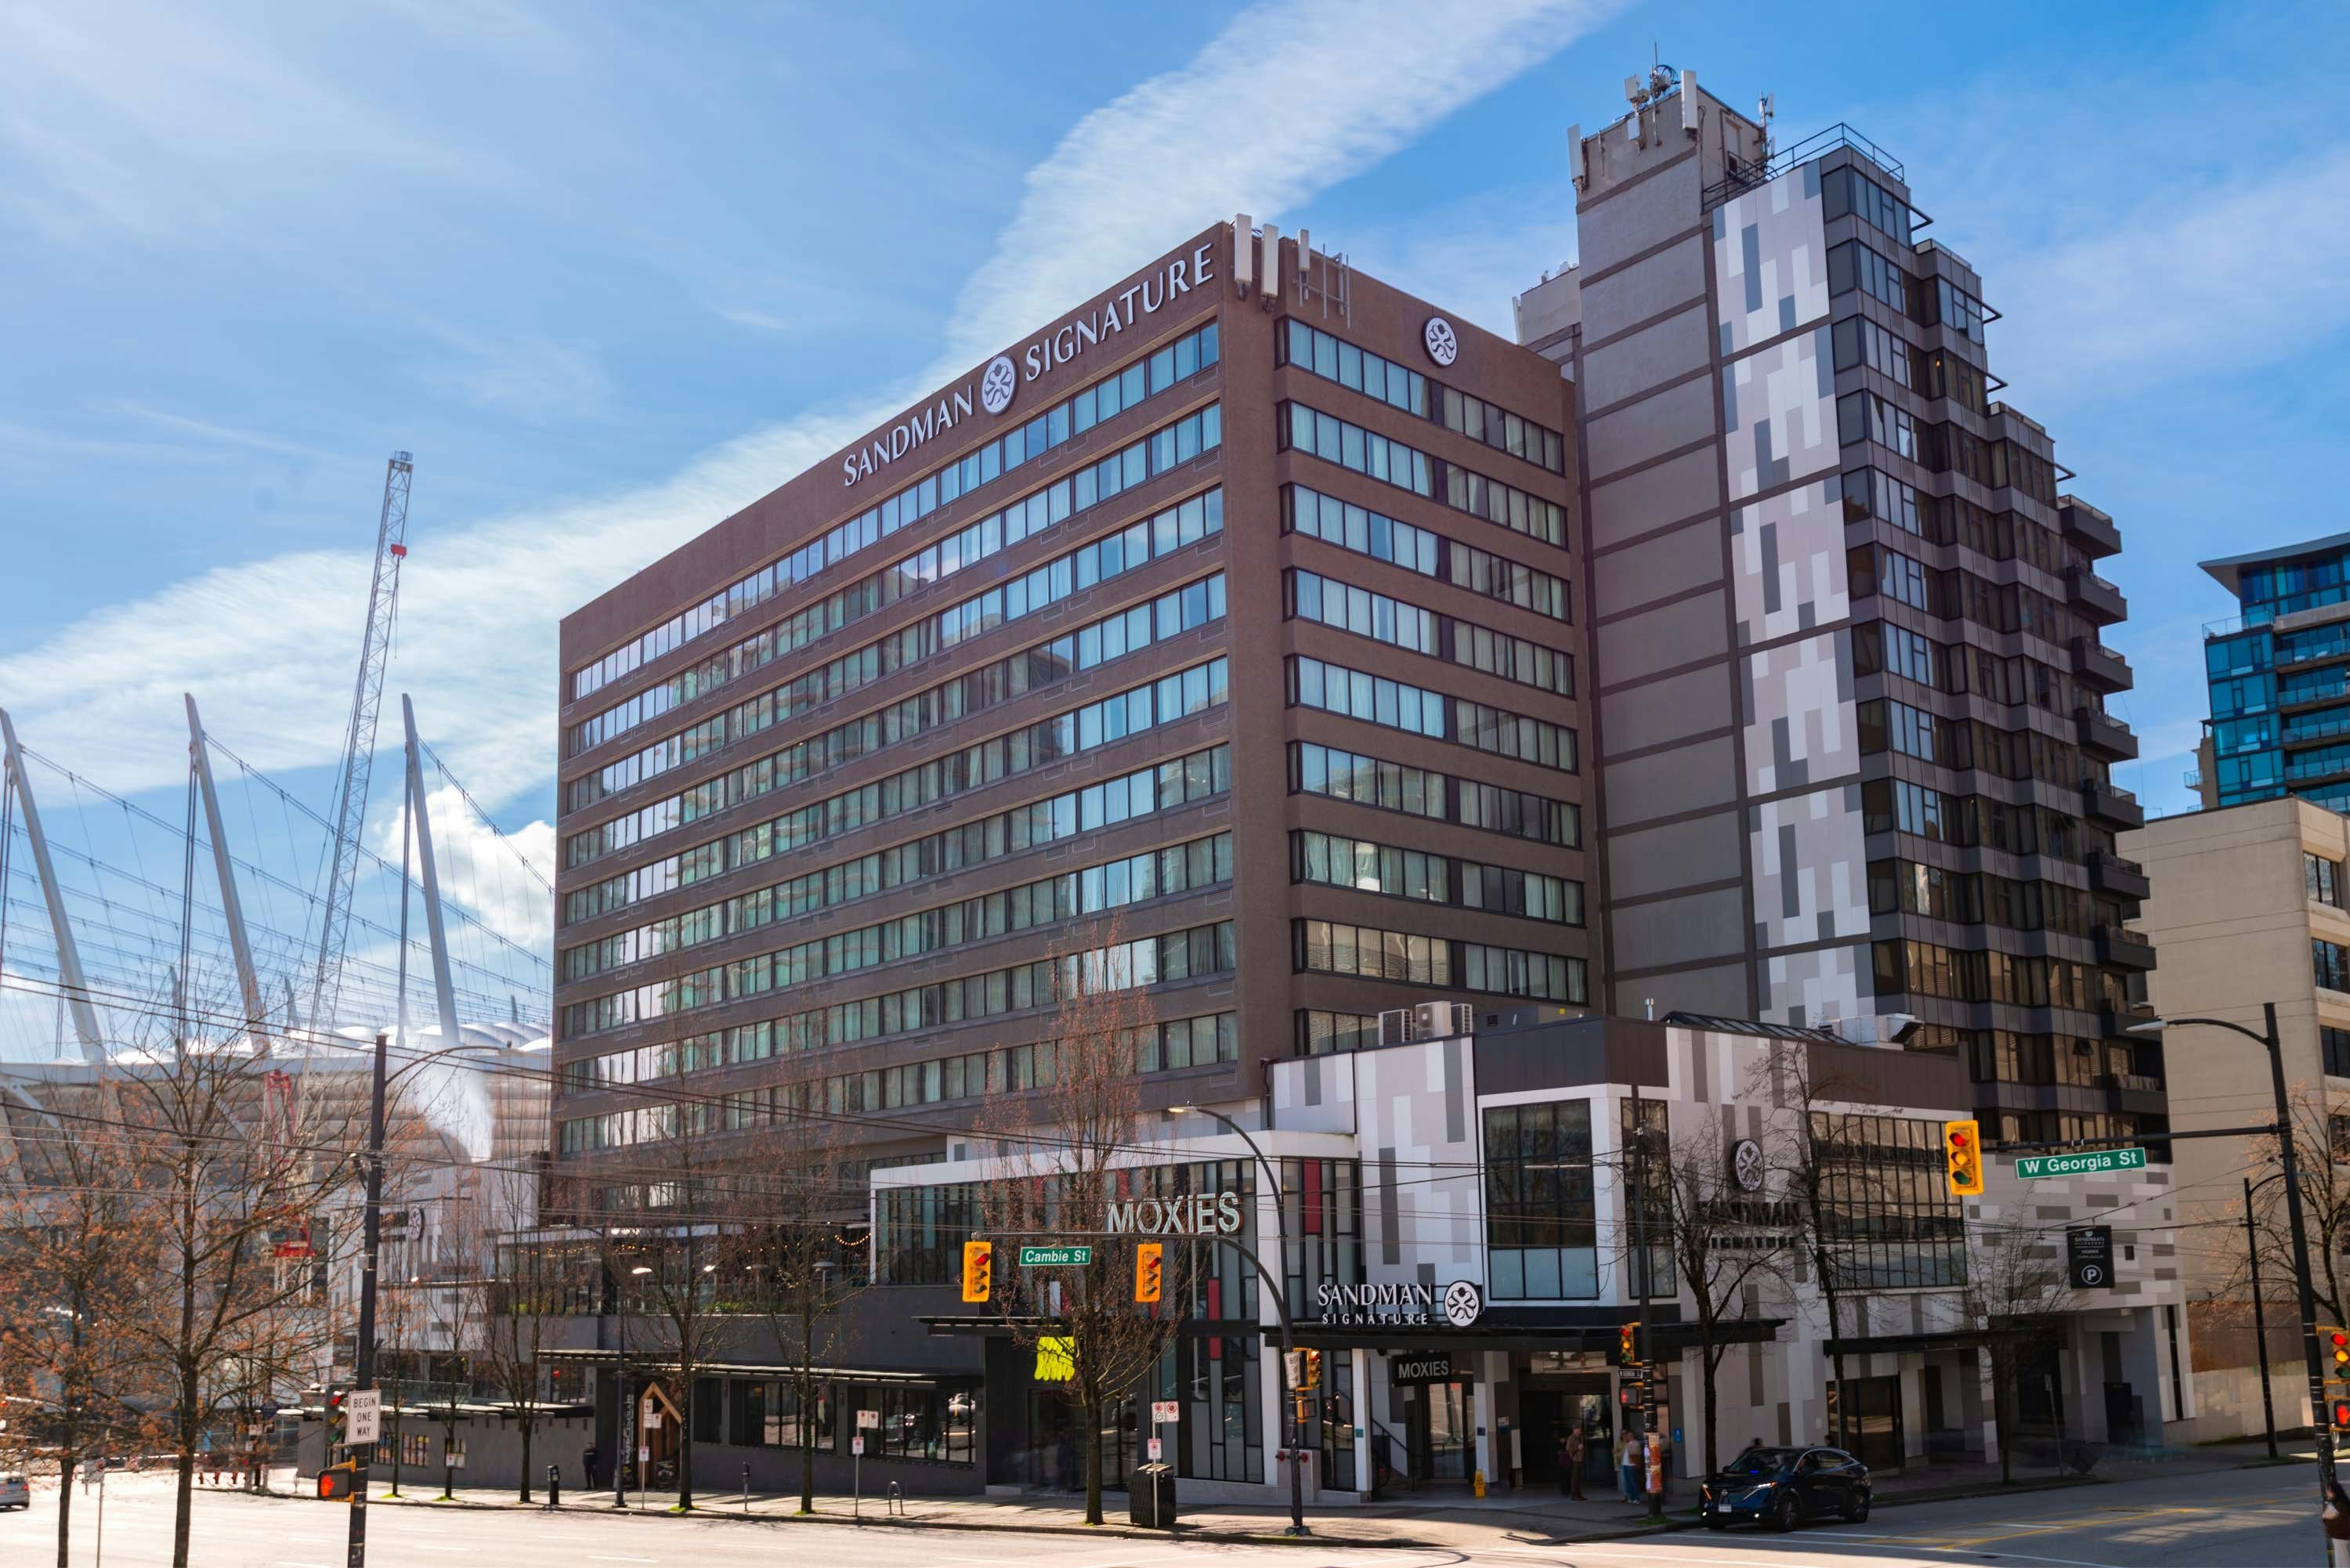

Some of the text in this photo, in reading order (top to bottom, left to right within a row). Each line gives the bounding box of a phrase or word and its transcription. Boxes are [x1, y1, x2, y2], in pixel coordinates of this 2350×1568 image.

[844, 243, 1214, 486] SANDMAN SIGNATURE
[2025, 1151, 2137, 1173] W Georgia St
[1108, 1191, 1241, 1234] MOXIES
[1025, 1250, 1086, 1262] Cambie St
[2087, 1269, 2097, 1281] P
[1318, 1284, 1432, 1306] SANDMAN
[1322, 1313, 1428, 1324] SIGNATURE
[1398, 1360, 1449, 1378] MOXIES
[353, 1397, 376, 1408] BEGIN
[357, 1412, 372, 1422] ONE
[357, 1426, 371, 1436] WAY
